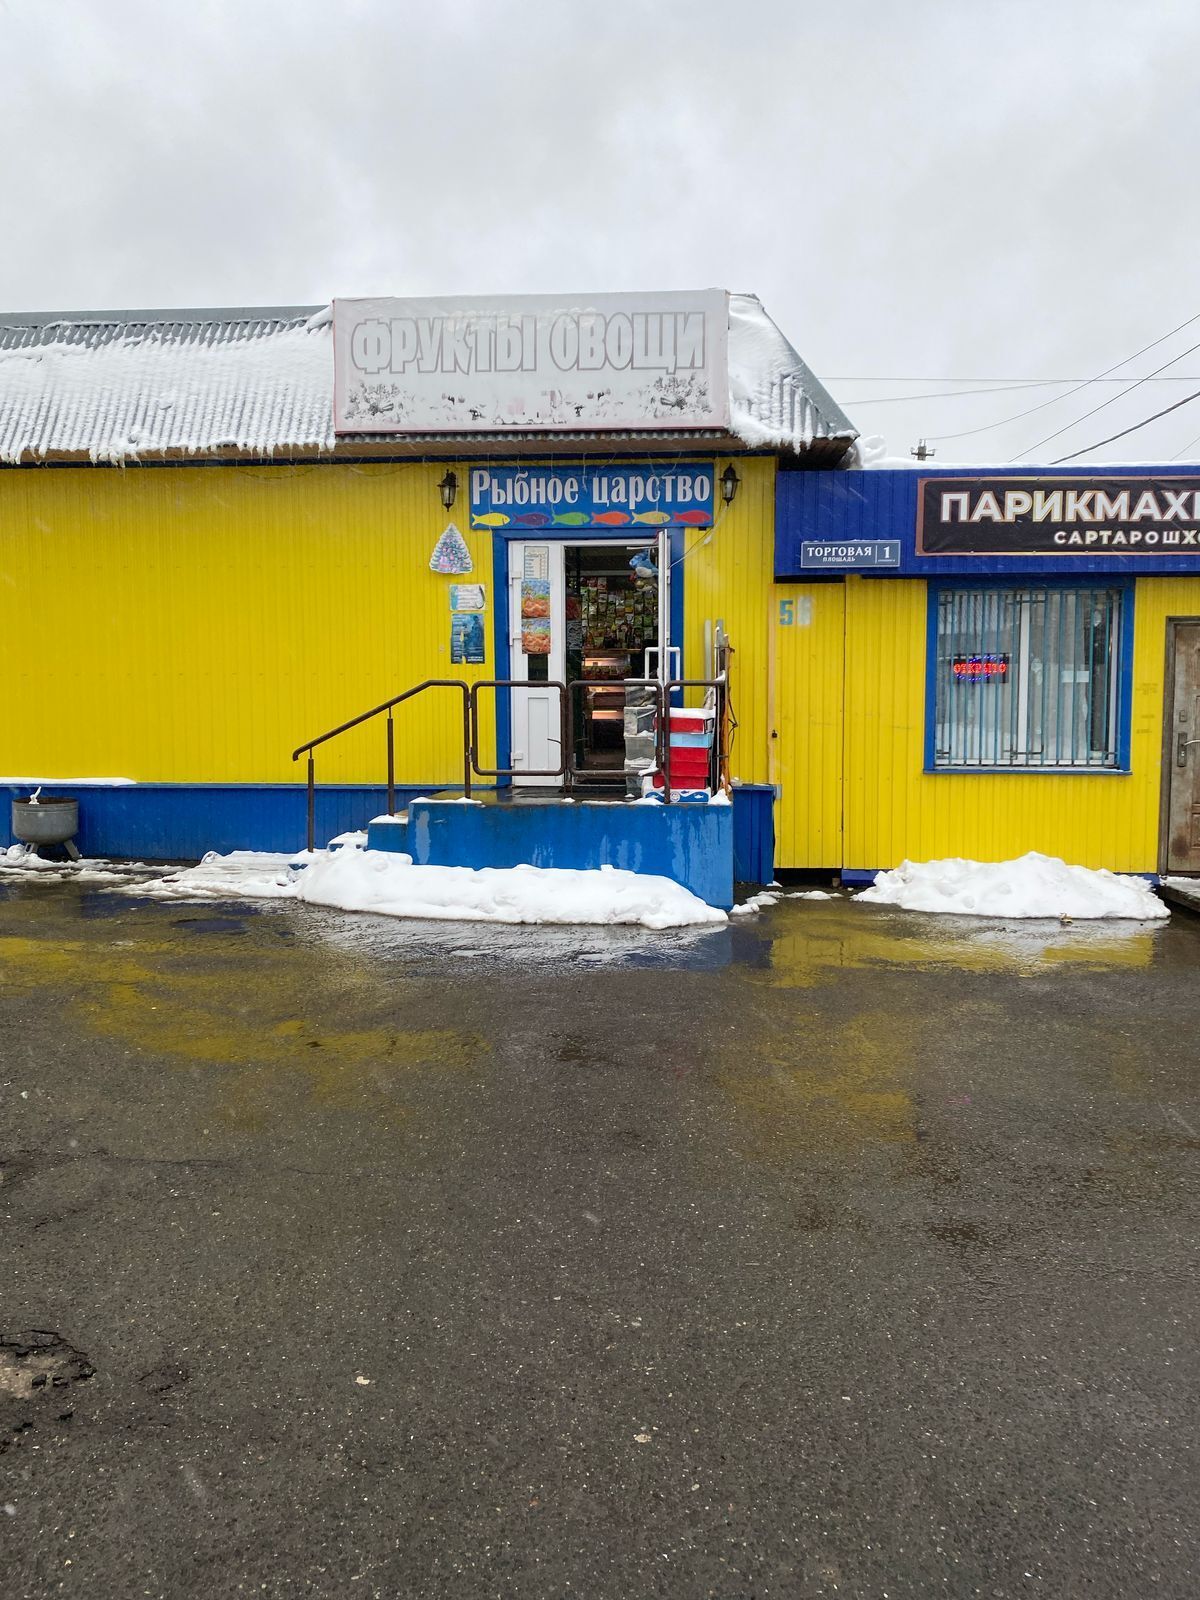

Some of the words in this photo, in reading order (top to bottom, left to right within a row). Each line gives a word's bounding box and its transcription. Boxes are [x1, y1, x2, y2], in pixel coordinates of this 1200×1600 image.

[351, 315, 537, 375] ФРУКТЫ
[549, 311, 706, 375] ОВОЩИ
[472, 470, 579, 505] Рыбное
[592, 474, 711, 509] царство
[940, 490, 1200, 523] ПАРИКМАХ
[807, 546, 872, 557] ТОРГОВАЯ
[884, 546, 890, 559] 1
[1053, 529, 1200, 545] САРТАРОШХ
